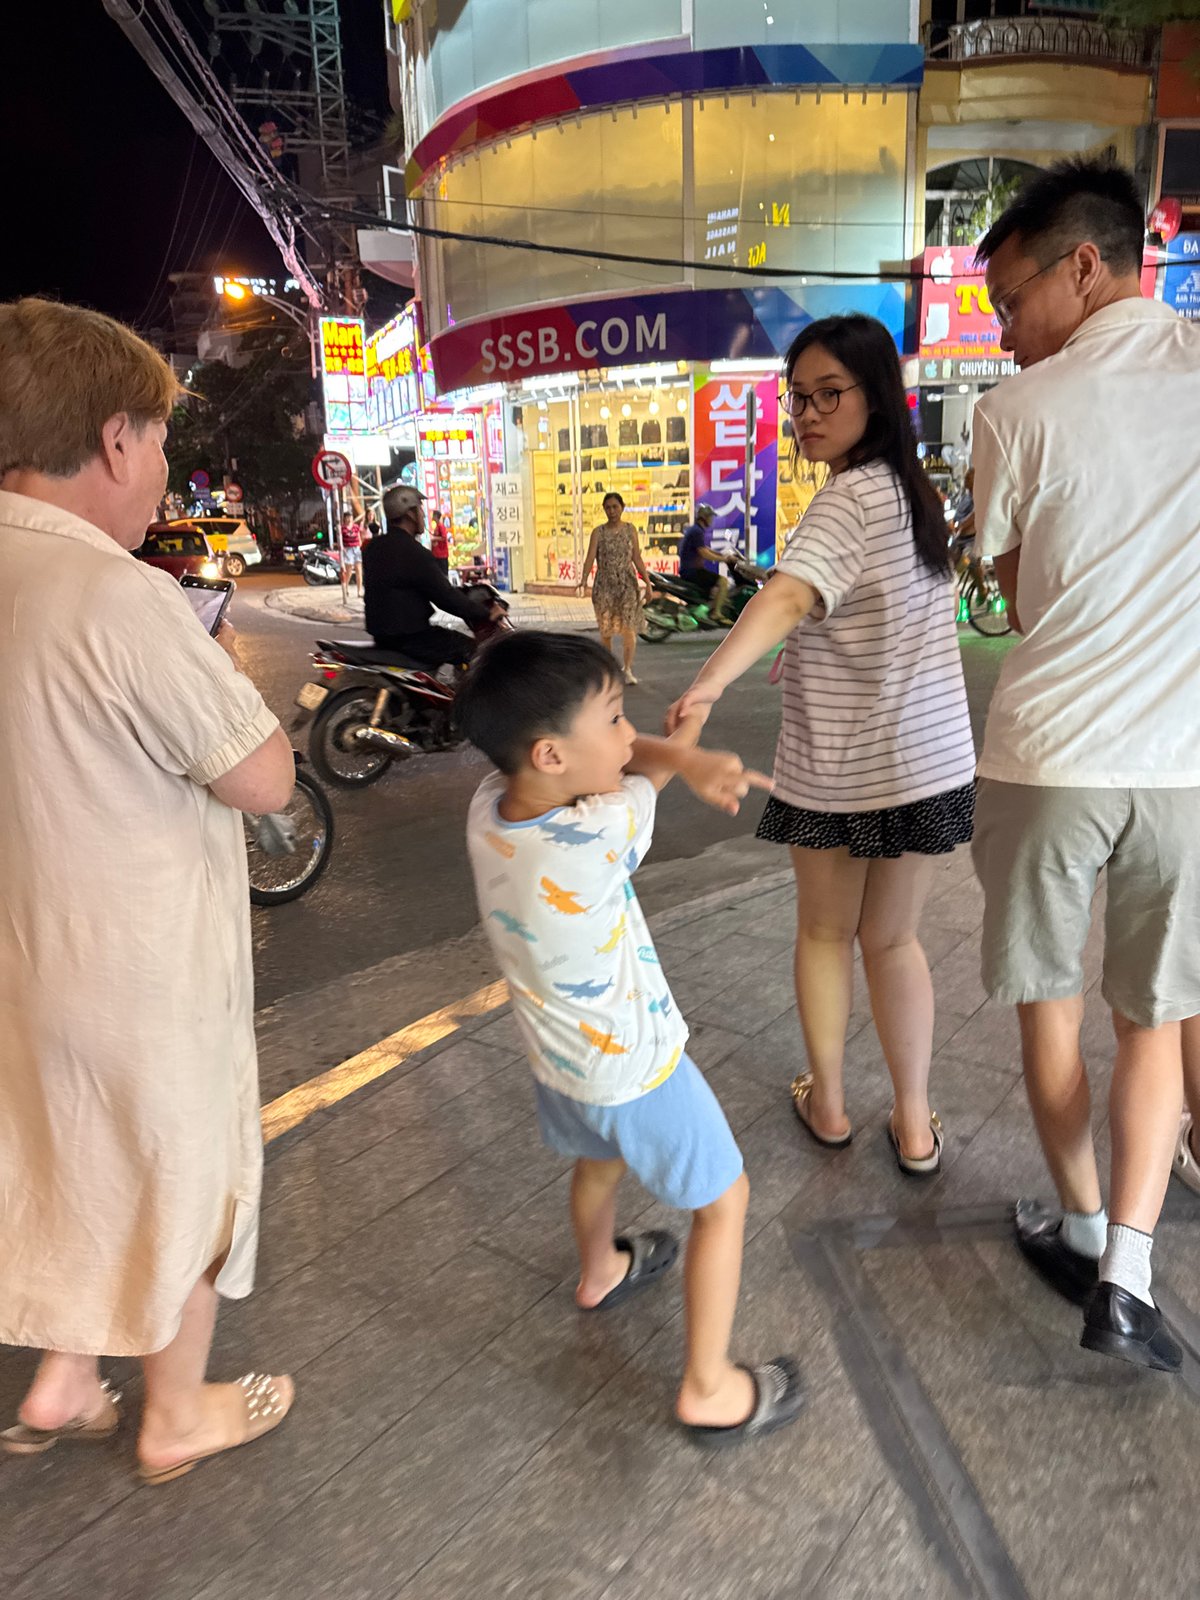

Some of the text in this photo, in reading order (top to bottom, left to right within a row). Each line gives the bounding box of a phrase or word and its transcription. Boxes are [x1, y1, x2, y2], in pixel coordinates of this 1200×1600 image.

[323, 321, 363, 348] Mart
[480, 312, 667, 374] SSSB.COM
[495, 480, 520, 497] 재고
[496, 505, 520, 522] 정리
[497, 530, 522, 545] 특가
